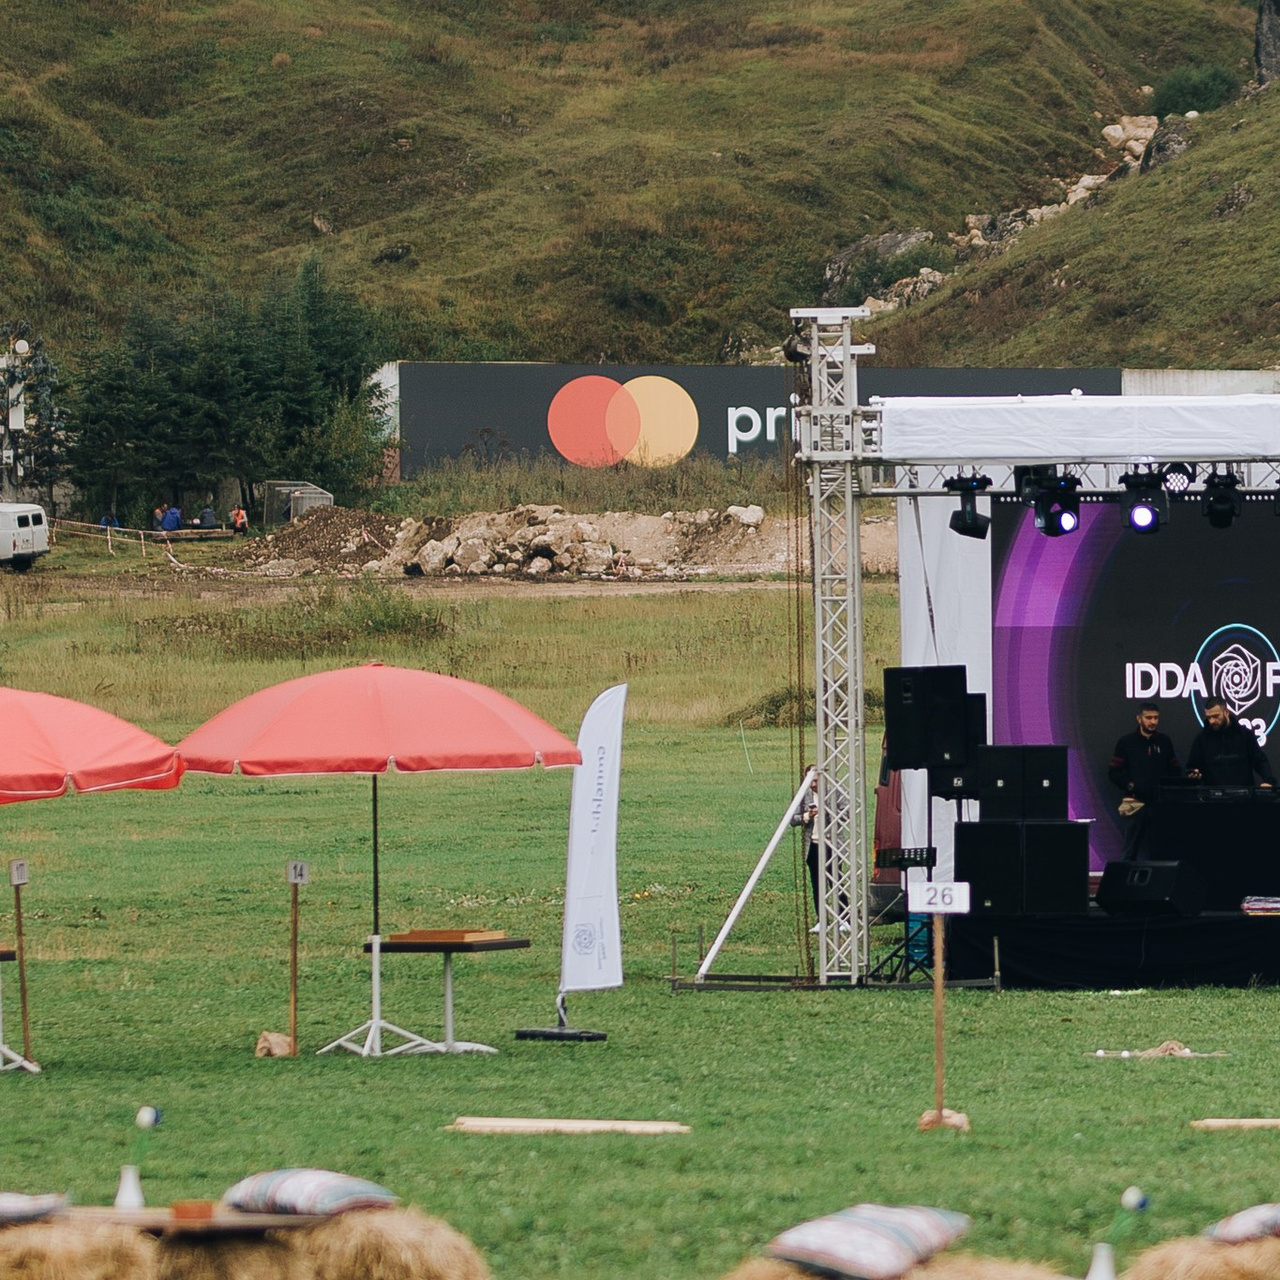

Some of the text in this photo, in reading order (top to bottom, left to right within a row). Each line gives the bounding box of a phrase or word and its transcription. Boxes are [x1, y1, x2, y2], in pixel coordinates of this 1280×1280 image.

[1125, 662, 1209, 699] IDDA
[292, 863, 304, 880] 14
[925, 886, 954, 906] 26
